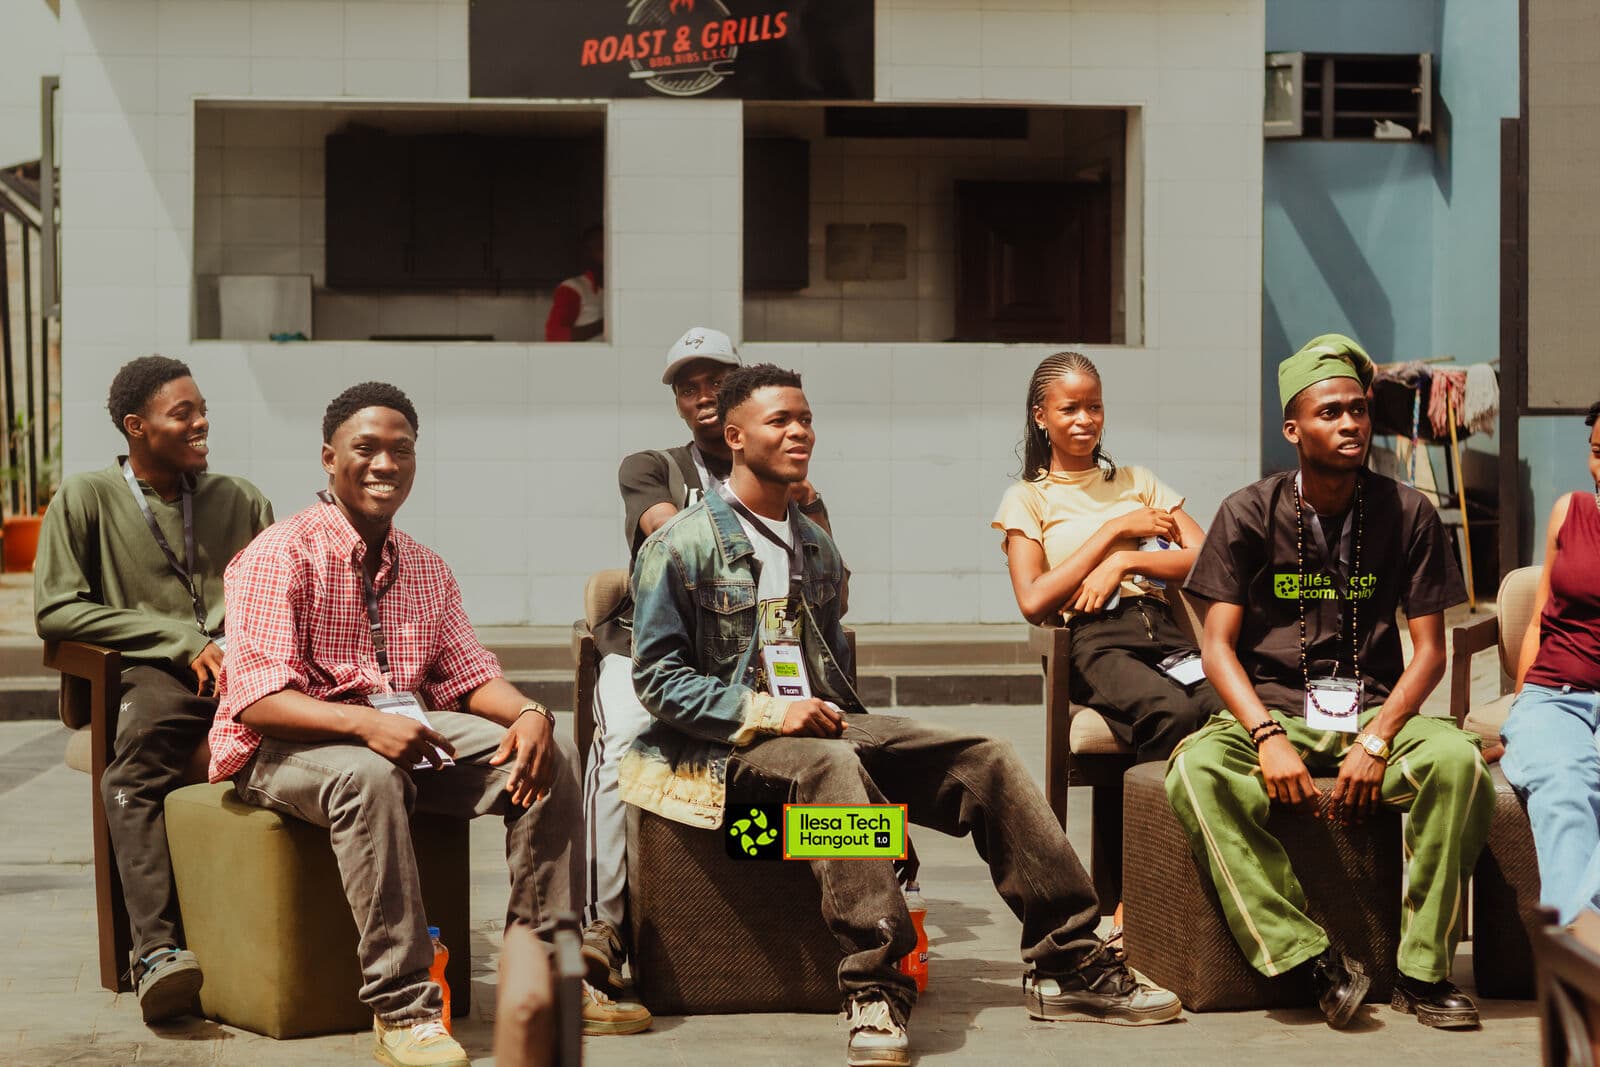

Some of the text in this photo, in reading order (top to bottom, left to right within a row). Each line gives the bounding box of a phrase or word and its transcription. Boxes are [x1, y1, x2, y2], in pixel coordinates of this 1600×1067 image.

[581, 11, 788, 66] ROAST & GRILLS
